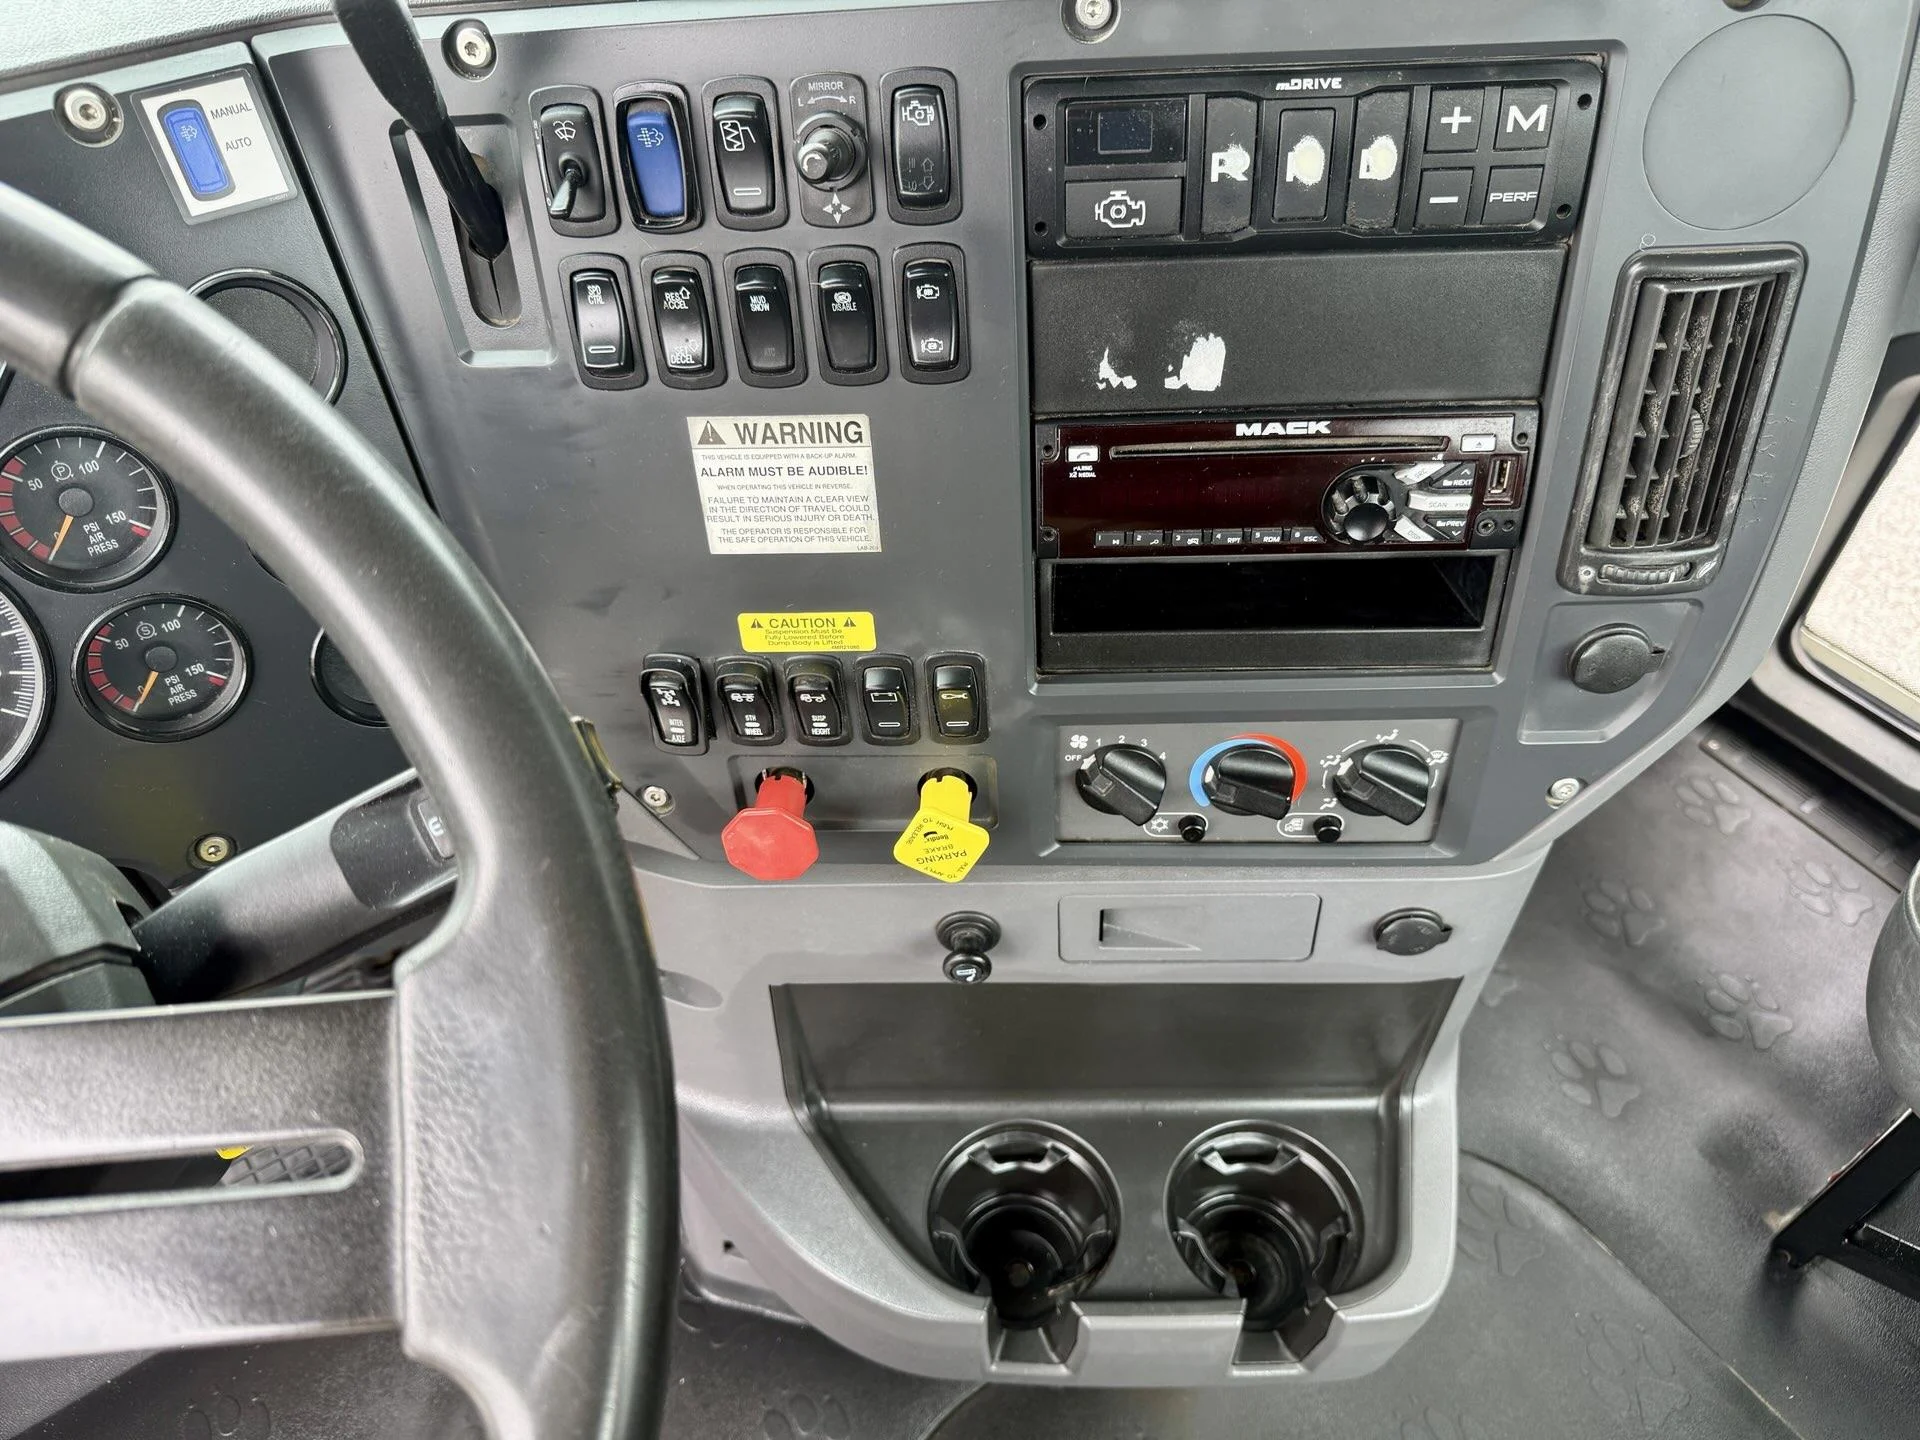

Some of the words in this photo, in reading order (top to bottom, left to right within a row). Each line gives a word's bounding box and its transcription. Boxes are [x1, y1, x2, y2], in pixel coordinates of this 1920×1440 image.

[807, 81, 844, 91] MIRROR
[797, 98, 804, 107] L
[849, 96, 857, 104] R
[210, 102, 252, 119] MANUAL
[1506, 104, 1548, 133] M
[225, 136, 252, 151] AUTO
[1210, 148, 1251, 183] R
[1489, 191, 1538, 203] PERF
[587, 285, 602, 296] SPD
[588, 295, 605, 305] CTRL
[663, 300, 689, 310] ACCEL
[750, 295, 766, 304] MUD
[750, 303, 770, 312] SNOW
[831, 301, 858, 312] DISABLE
[671, 354, 695, 364] DECEL
[734, 420, 863, 445] WARNING
[1235, 421, 1331, 436] MACK
[78, 459, 100, 475] 100
[701, 467, 745, 477] ALARM
[748, 466, 783, 477] MUST
[787, 466, 805, 476] BE
[808, 465, 868, 476] AUDIBLE!
[27, 478, 43, 491] 50
[707, 496, 745, 504] FAILURE
[747, 496, 760, 504] TO
[761, 496, 804, 504] MAINTAIN
[815, 495, 844, 503] CLEAR
[846, 495, 869, 503] VIEW
[719, 505, 737, 513] THE
[740, 505, 786, 513] DIRECTION
[788, 505, 800, 513] OF
[839, 504, 870, 512] COULD
[105, 510, 127, 525] 150
[706, 515, 741, 523] RESULT
[82, 521, 101, 534] PSI
[738, 527, 782, 535] OPERATOR
[88, 532, 106, 545] AIR
[718, 536, 734, 544] THE
[817, 535, 835, 543] THIS
[87, 538, 119, 557] PRESS
[161, 619, 181, 633] 100
[769, 618, 836, 629] CAUTION
[114, 638, 130, 650] 50
[184, 662, 205, 677] 150
[164, 675, 181, 687] PSI
[169, 683, 186, 696] AIR
[167, 689, 198, 706] PRESS
[811, 714, 827, 722] SUSP
[745, 727, 764, 736] WHEEL
[811, 727, 831, 736] HEIGHT
[671, 733, 686, 743] AXLE
[1095, 738, 1101, 747] 1
[1118, 735, 1126, 744] 2
[1140, 738, 1148, 747] 3
[1064, 754, 1082, 762] OFF
[1159, 751, 1166, 760] 4
[936, 820, 954, 831] PUSH
[906, 823, 924, 845] RELEASE
[923, 843, 954, 854] BRAKE
[916, 849, 967, 865] PARKING
